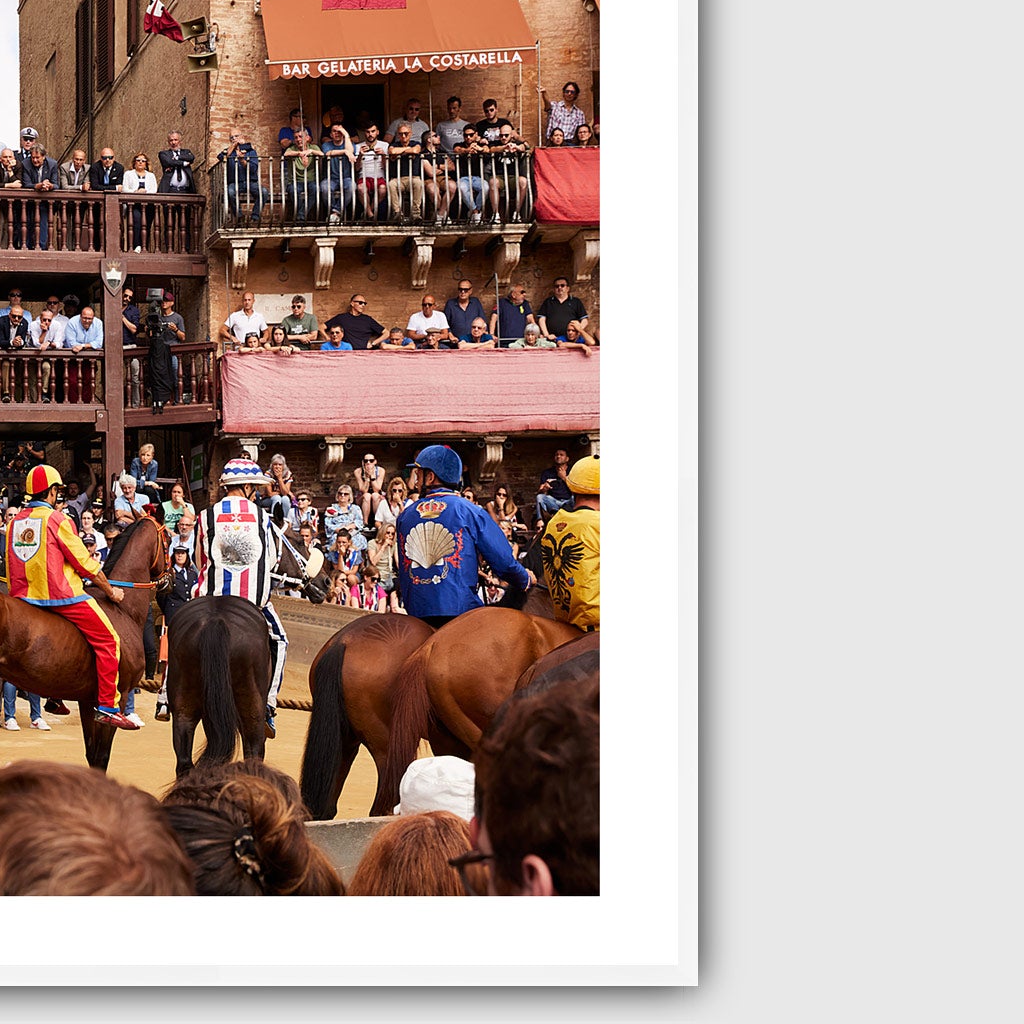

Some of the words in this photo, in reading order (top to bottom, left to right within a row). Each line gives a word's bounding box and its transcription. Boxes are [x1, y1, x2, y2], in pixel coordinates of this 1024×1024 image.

[282, 63, 311, 76] BAR
[317, 58, 397, 74] GELATERIA
[404, 56, 423, 69] LA
[429, 50, 523, 68] COSTARELLA
